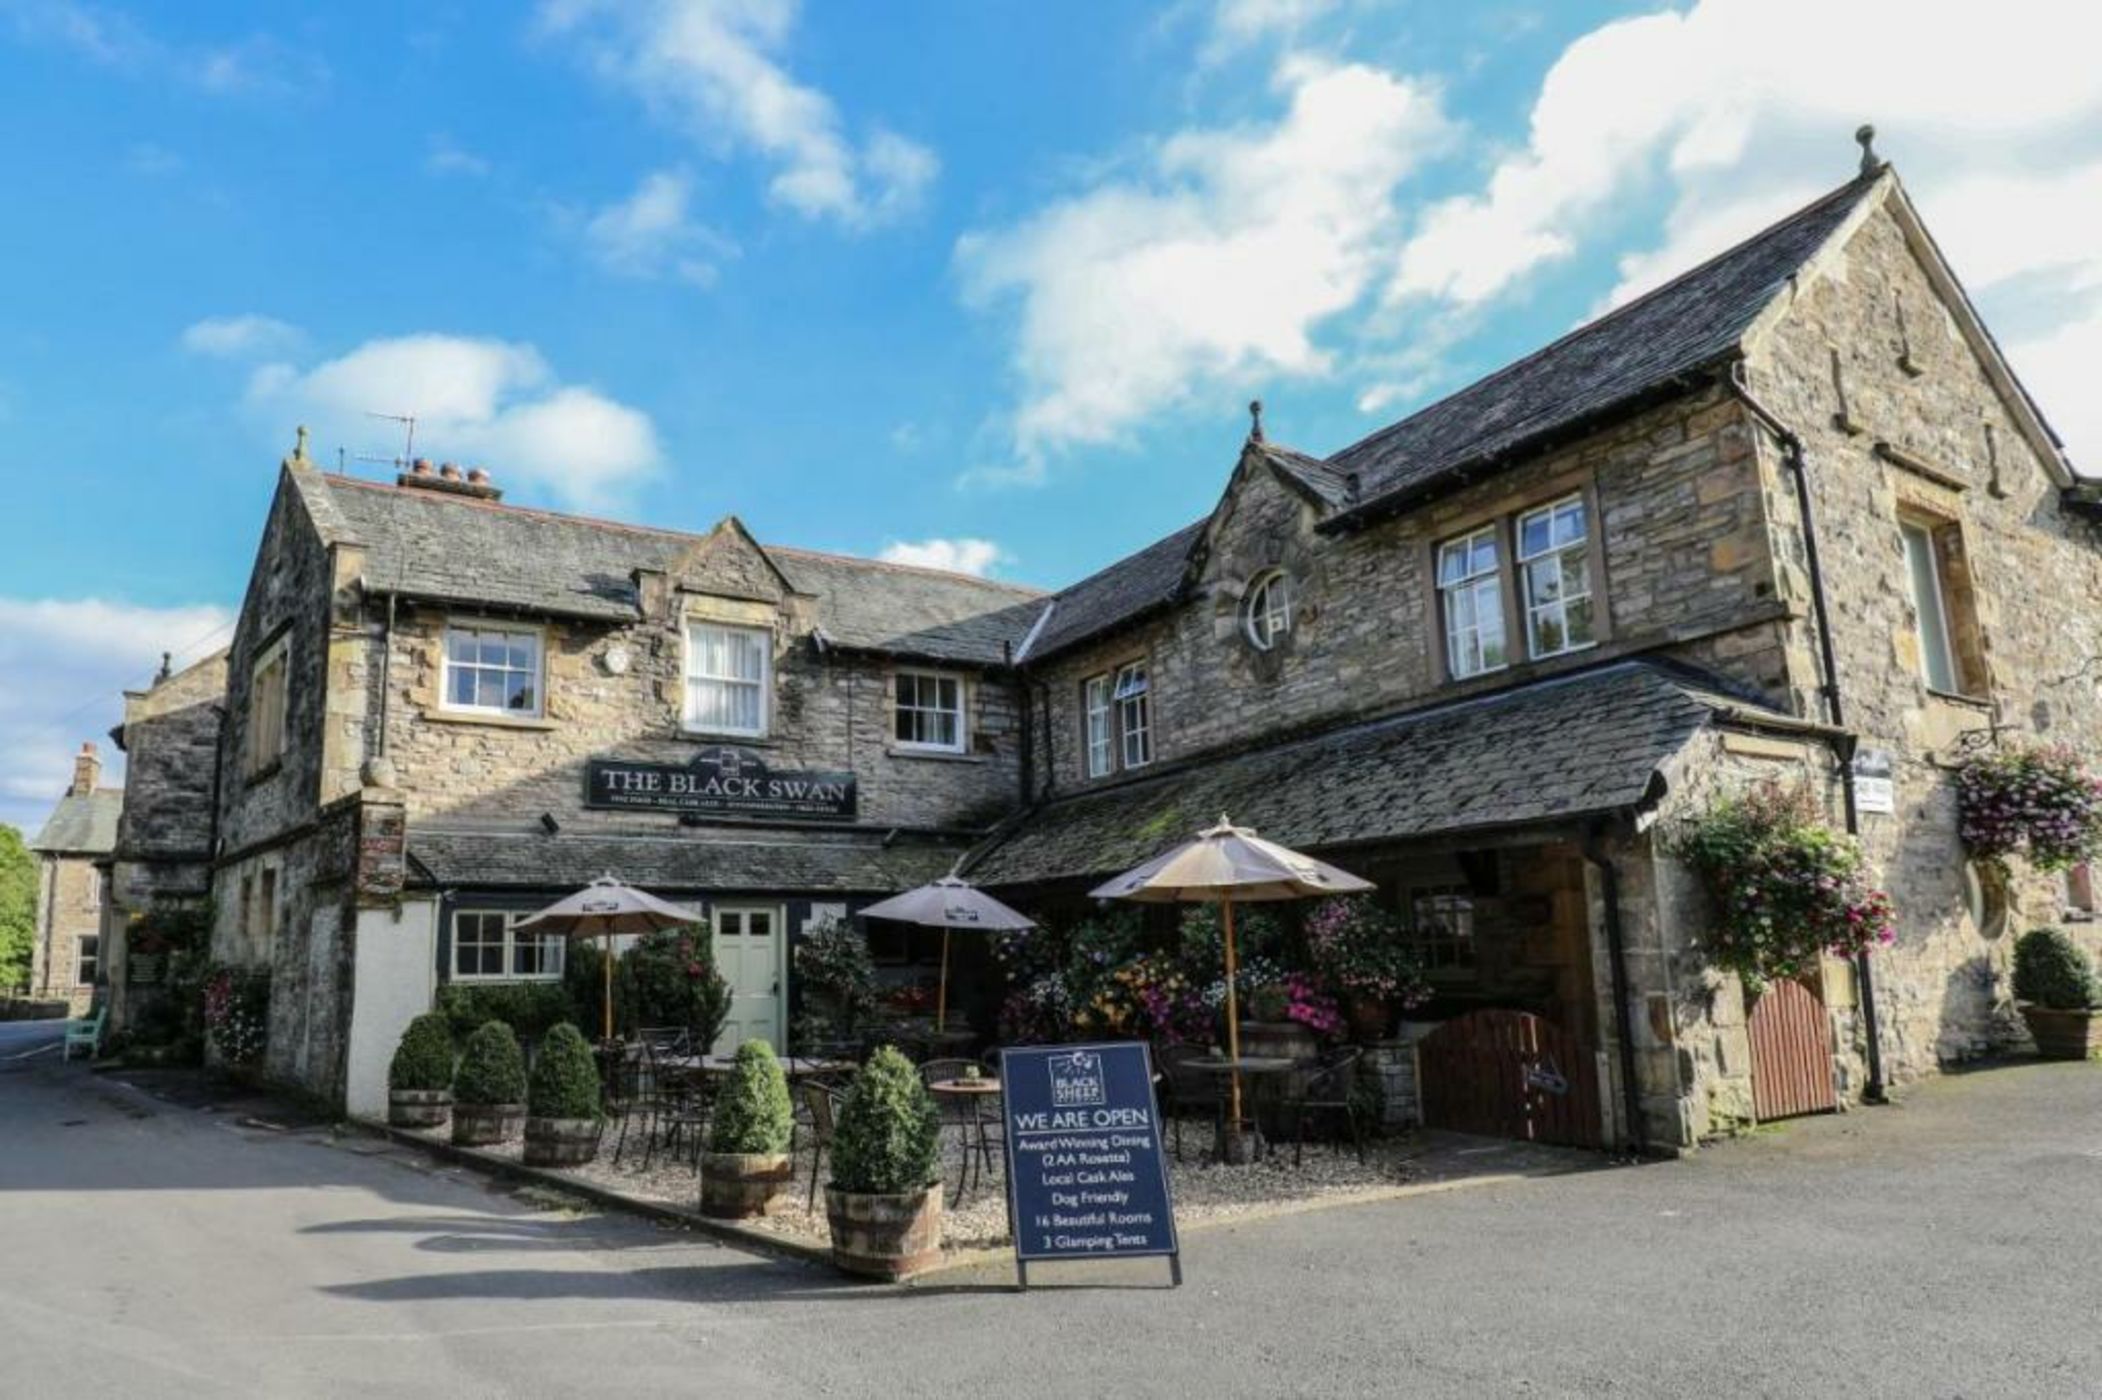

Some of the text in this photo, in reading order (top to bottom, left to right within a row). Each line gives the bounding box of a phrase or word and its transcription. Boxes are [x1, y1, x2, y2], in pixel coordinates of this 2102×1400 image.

[602, 769, 846, 800] THE BLACK SWAN
[1056, 1076, 1098, 1088] BLACK
[1056, 1087, 1100, 1099] SHEEP
[1015, 1108, 1149, 1130] WE ARE OPEN
[1018, 1134, 1151, 1151] Award Winning Dining
[1056, 1154, 1077, 1165] AA
[1042, 1172, 1135, 1186] Local Cask Ales
[1052, 1190, 1130, 1207] Dog Friendly
[1036, 1211, 1153, 1227] 16 Beautiful Rooms
[1043, 1233, 1148, 1250] 3 Glamping Tents
